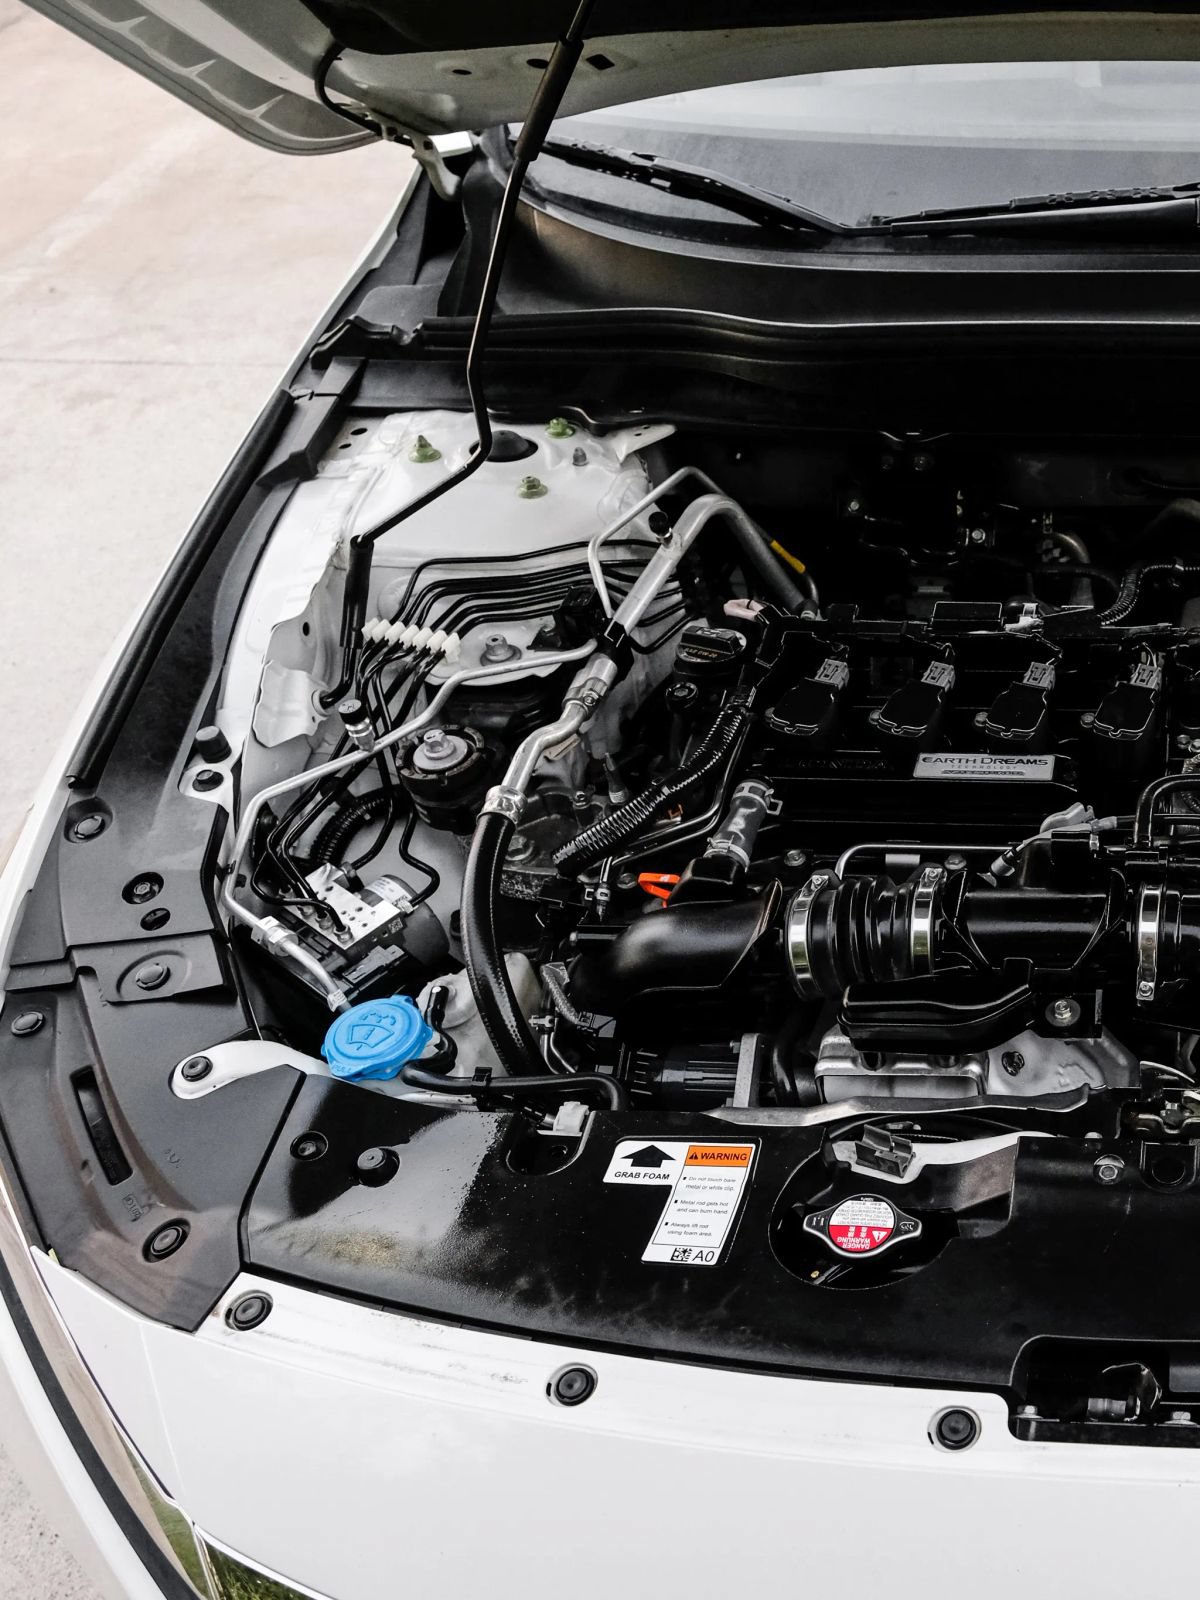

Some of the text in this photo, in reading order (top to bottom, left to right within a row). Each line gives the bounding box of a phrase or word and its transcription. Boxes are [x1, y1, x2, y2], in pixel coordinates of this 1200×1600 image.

[922, 756, 1048, 766] EARTH DREAMS
[614, 1171, 670, 1180] GRAB FOAM
[692, 1251, 715, 1262] A0
